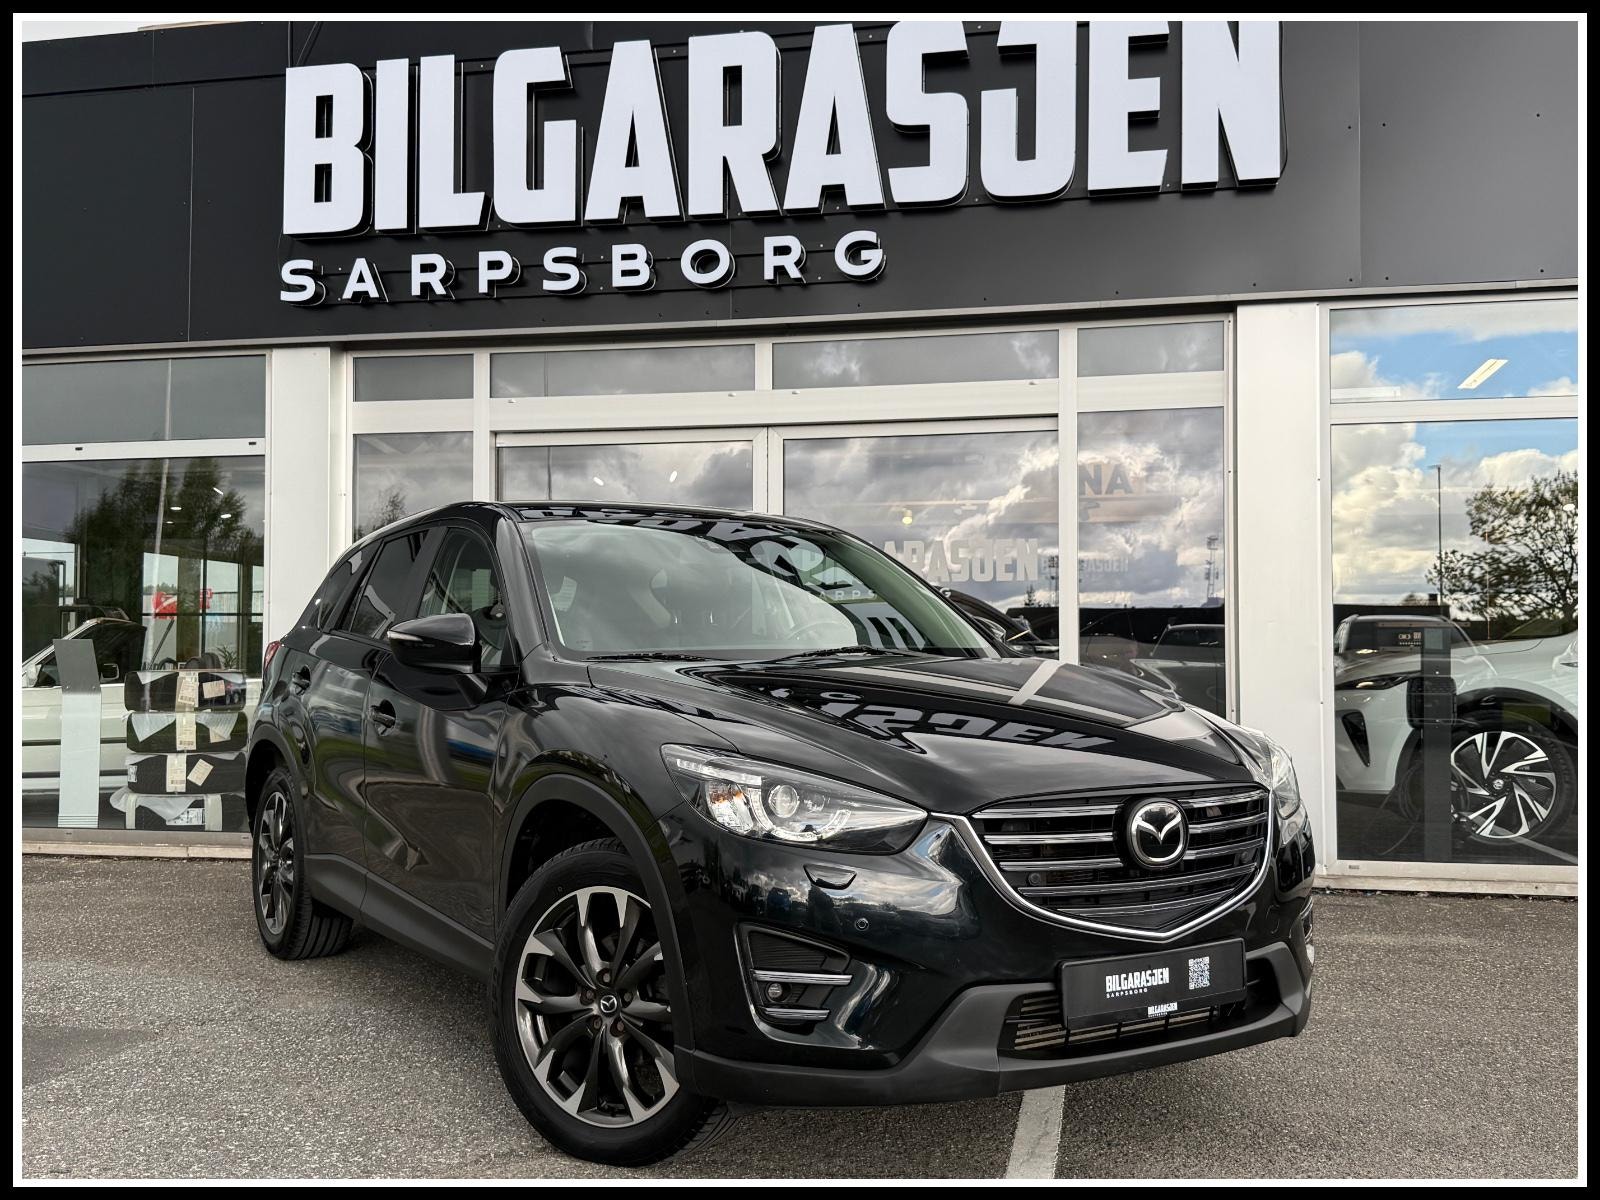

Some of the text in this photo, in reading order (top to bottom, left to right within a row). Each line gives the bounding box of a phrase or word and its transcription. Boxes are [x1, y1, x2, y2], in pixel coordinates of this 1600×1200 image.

[283, 22, 1281, 235] BILGARASJEN
[280, 230, 885, 303] SARPSBORG
[1105, 967, 1170, 993] BILGARASJEN
[1106, 987, 1148, 999] SARPSBORG
